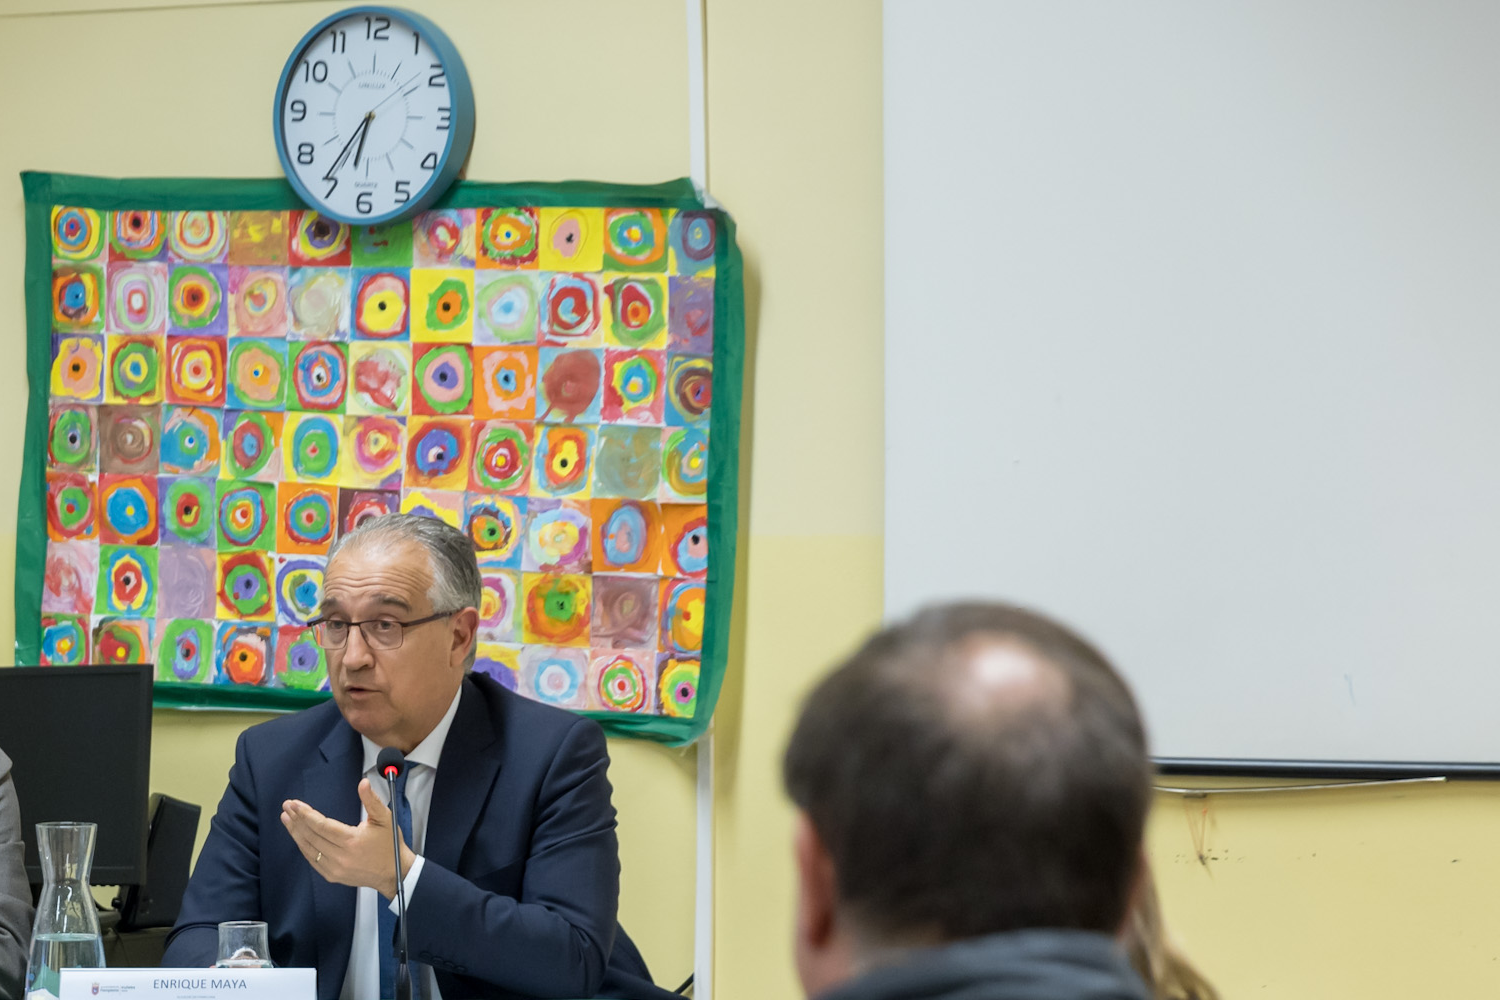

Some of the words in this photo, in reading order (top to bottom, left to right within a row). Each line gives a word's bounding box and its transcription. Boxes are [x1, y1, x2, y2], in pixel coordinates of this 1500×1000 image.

[364, 16, 391, 41] 12
[330, 30, 346, 54] 11
[412, 31, 420, 56] 1
[303, 60, 328, 83] 10
[428, 64, 446, 88] 2
[290, 99, 307, 123] 9
[436, 107, 451, 130] 3
[297, 142, 315, 165] 8
[420, 152, 438, 170] 4
[322, 176, 339, 200] 7
[394, 180, 411, 204] 5
[356, 192, 373, 215] 6
[153, 979, 207, 991] ENRIQUE
[211, 979, 247, 990] MAYA
